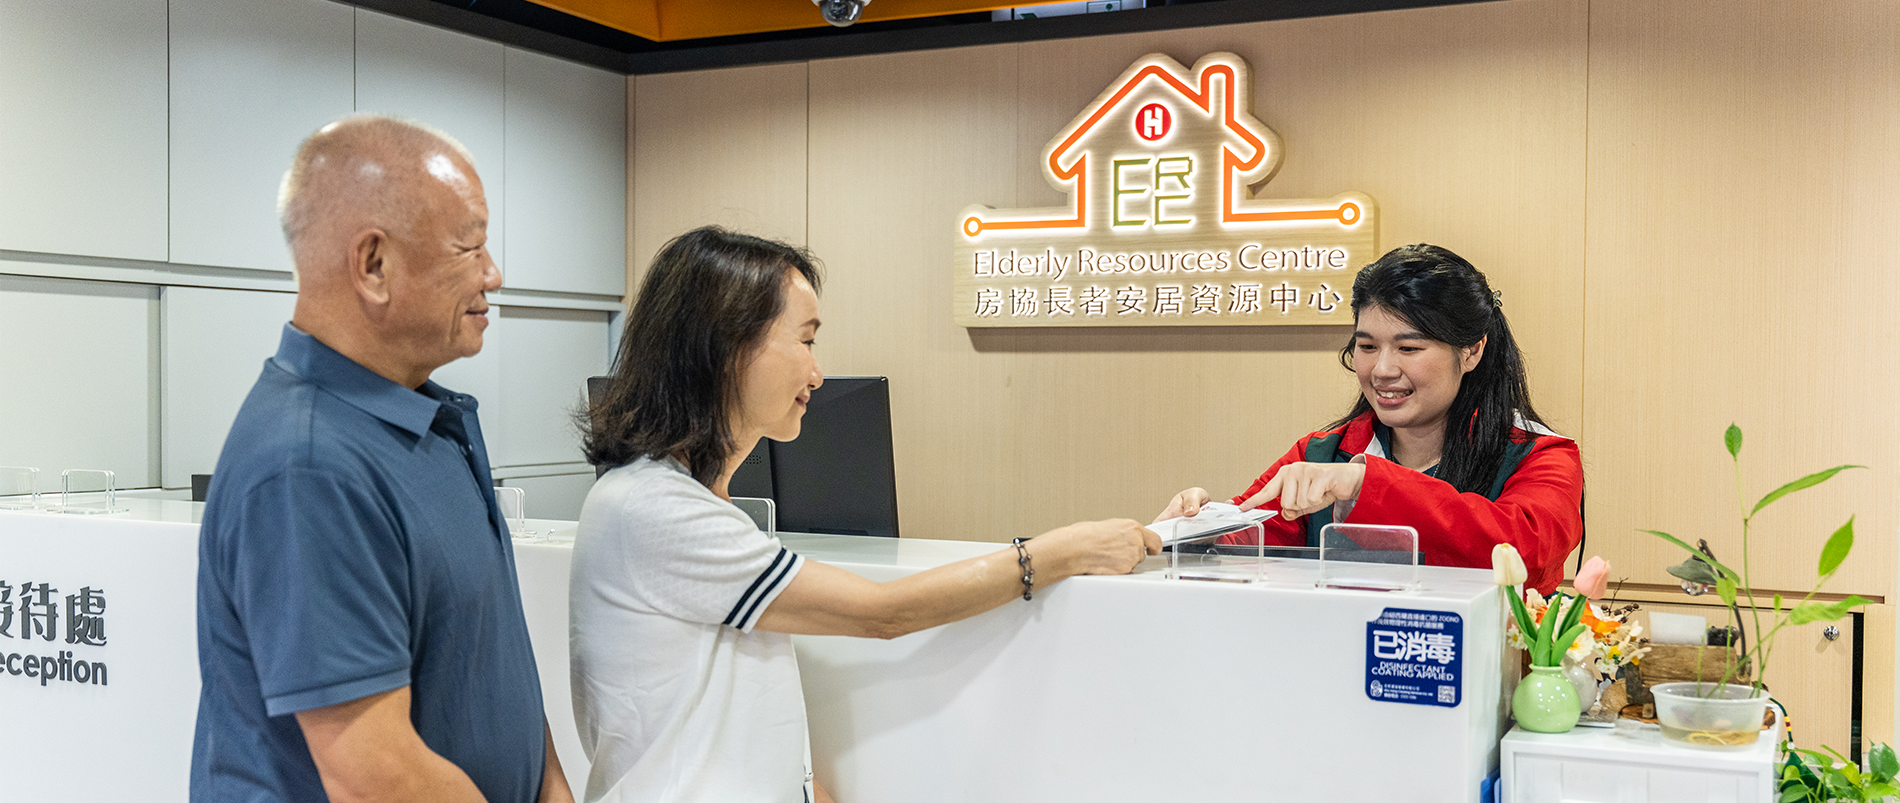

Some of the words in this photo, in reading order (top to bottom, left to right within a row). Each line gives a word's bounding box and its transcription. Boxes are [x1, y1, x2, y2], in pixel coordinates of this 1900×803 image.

[973, 248, 1068, 281] Elderly
[1078, 247, 1228, 276] Resources
[1236, 243, 1347, 272] Centre
[973, 281, 1342, 318] 房協長者安居資源中心
[1373, 629, 1456, 665] 已消毒
[1371, 666, 1415, 678] COATING
[1415, 671, 1455, 681] APPLIED
[1379, 661, 1446, 674] DISINFECTANT
